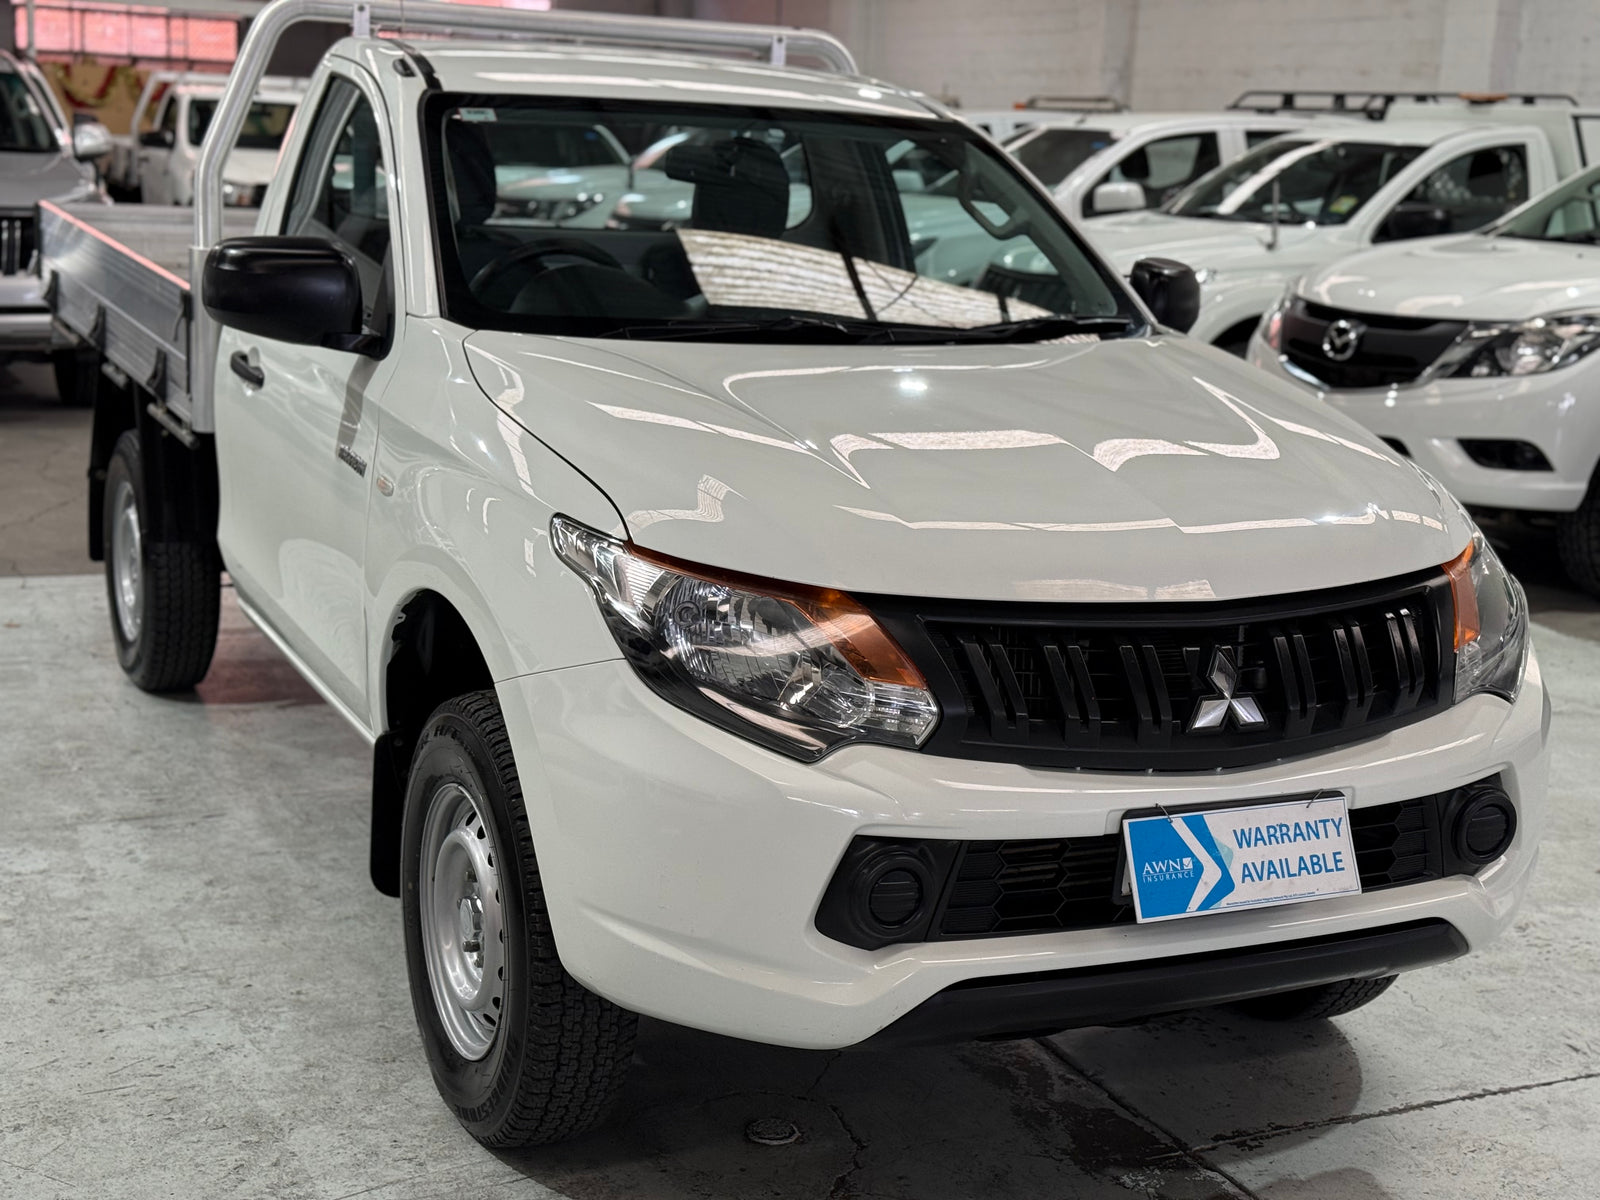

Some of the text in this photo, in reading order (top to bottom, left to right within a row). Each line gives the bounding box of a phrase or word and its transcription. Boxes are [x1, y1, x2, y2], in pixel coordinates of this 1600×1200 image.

[1232, 817, 1343, 849] WARRANTY
[1143, 859, 1181, 875] AWN
[1143, 870, 1195, 883] INSURANCE
[1241, 851, 1345, 884] AVAILABLE
